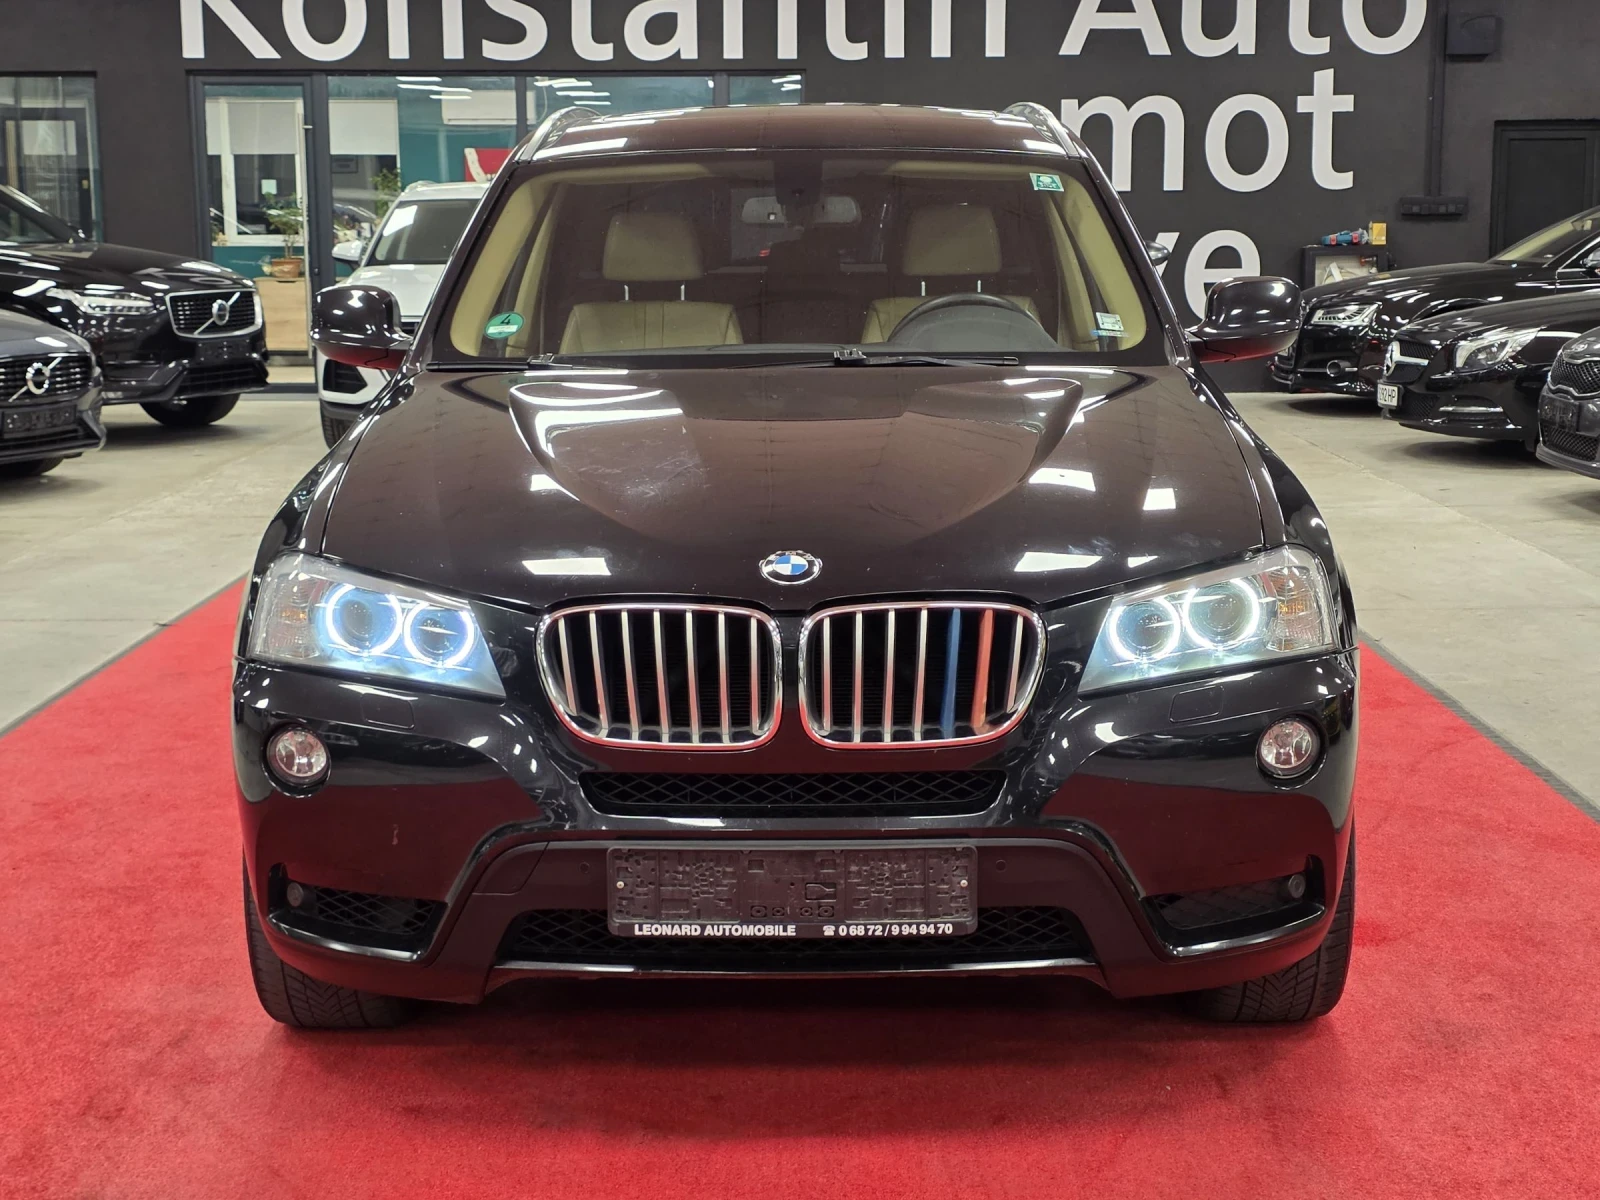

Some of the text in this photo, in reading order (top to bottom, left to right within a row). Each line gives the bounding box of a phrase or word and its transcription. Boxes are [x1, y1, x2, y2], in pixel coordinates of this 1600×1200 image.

[1060, 68, 1354, 192] mot
[1154, 229, 1261, 320] e
[500, 313, 511, 325] 4
[634, 924, 796, 936] LEONARD AUTOMOBILE
